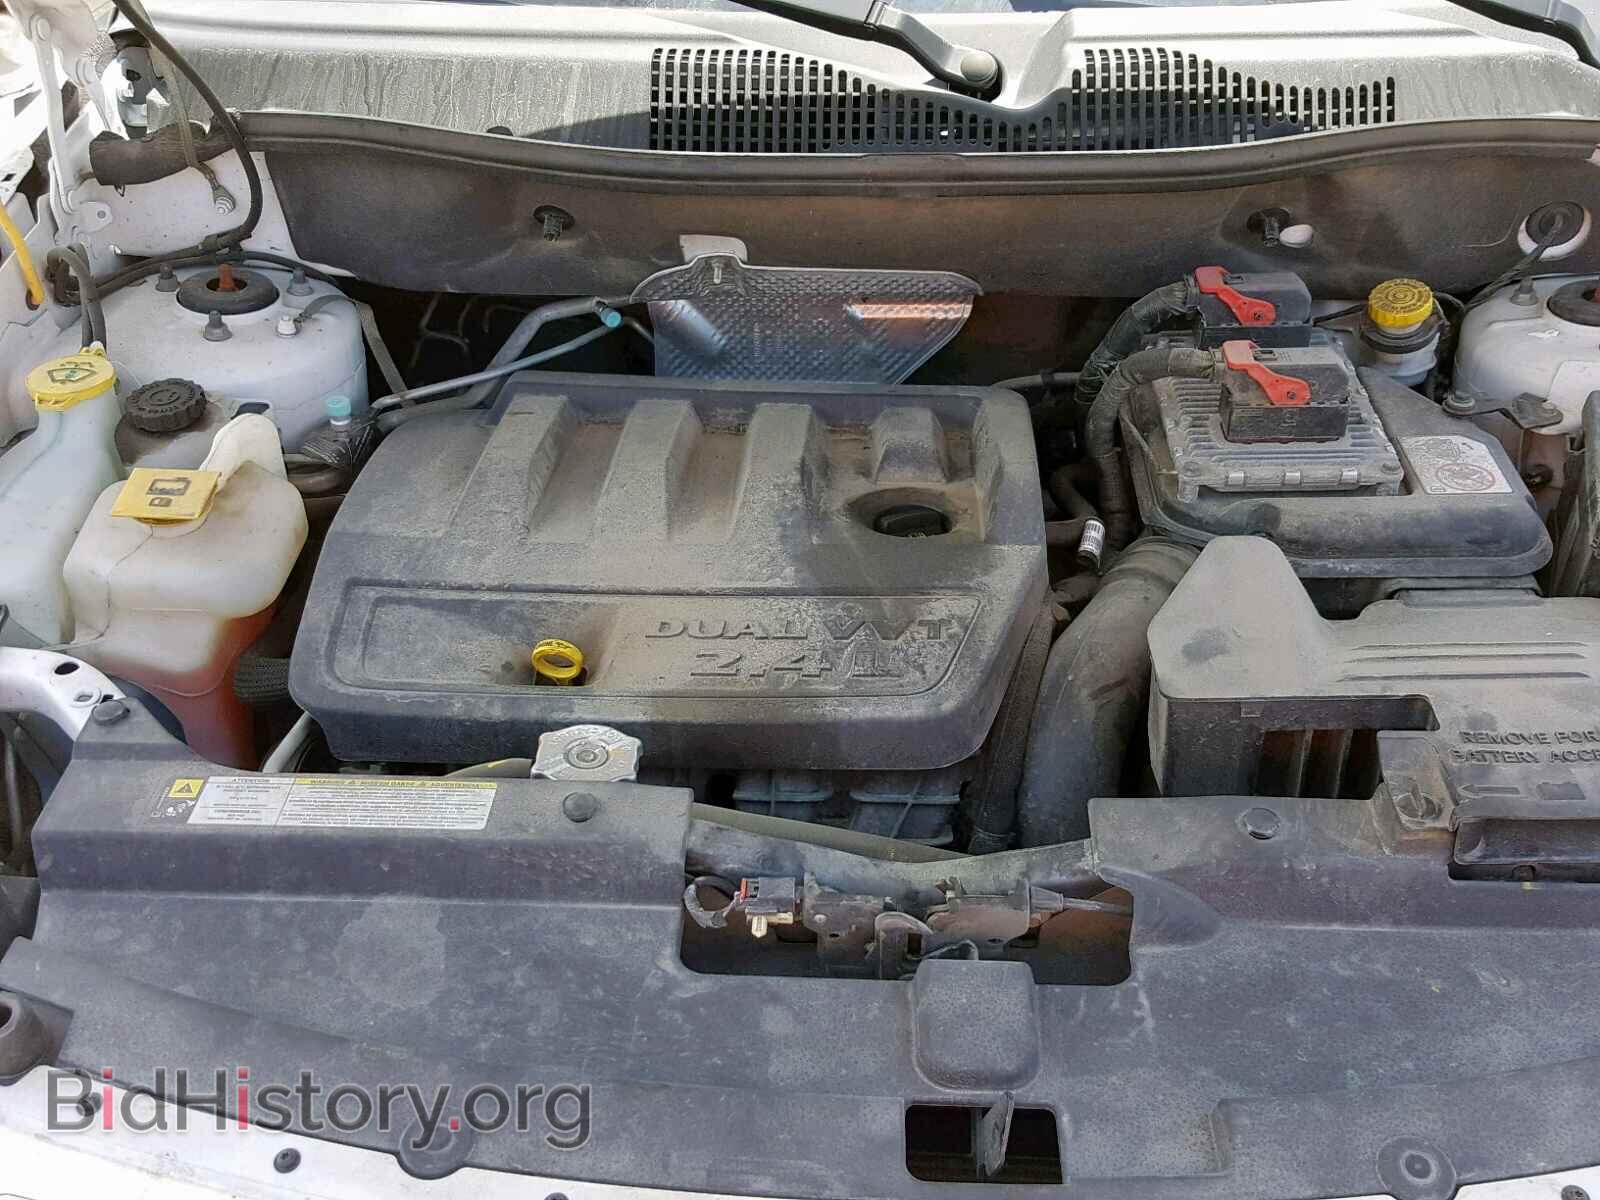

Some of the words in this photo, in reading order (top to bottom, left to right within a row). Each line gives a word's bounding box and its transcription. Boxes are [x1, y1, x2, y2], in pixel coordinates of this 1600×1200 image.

[645, 620, 808, 640] DUAL
[1459, 730, 1552, 746] REMOVE
[1553, 729, 1600, 745] FOR
[1448, 748, 1541, 764] BATTERY
